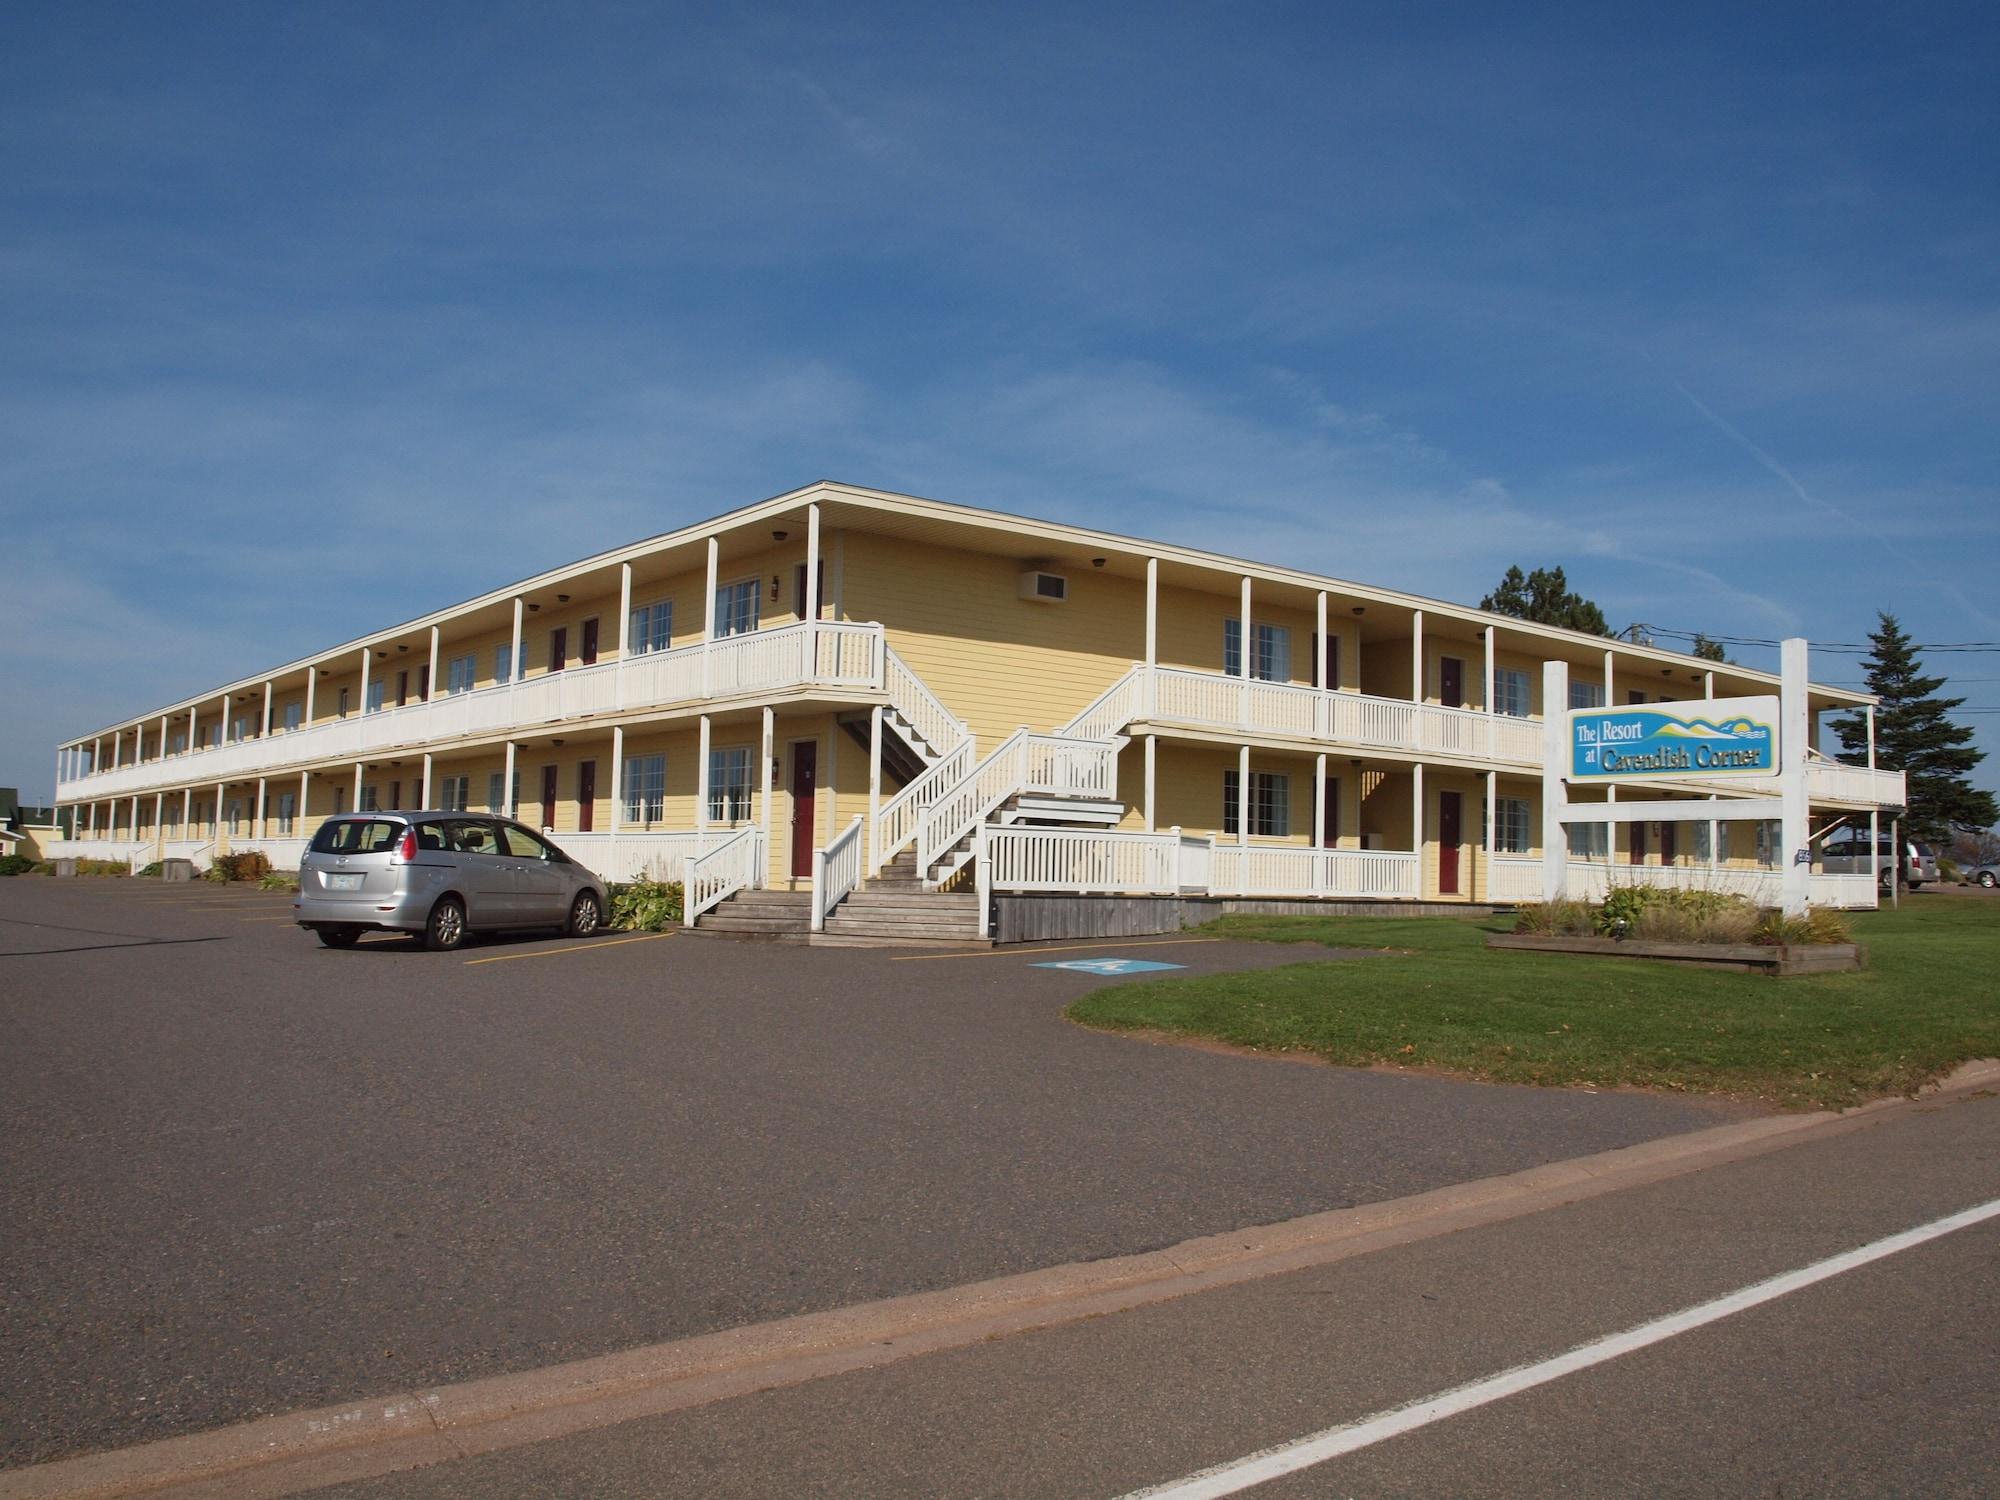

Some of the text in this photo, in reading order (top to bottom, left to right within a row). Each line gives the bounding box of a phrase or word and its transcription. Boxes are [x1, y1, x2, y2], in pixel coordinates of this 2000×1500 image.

[1577, 720, 1643, 741] The Resort
[1585, 743, 1760, 772] at Cavendish Corner
